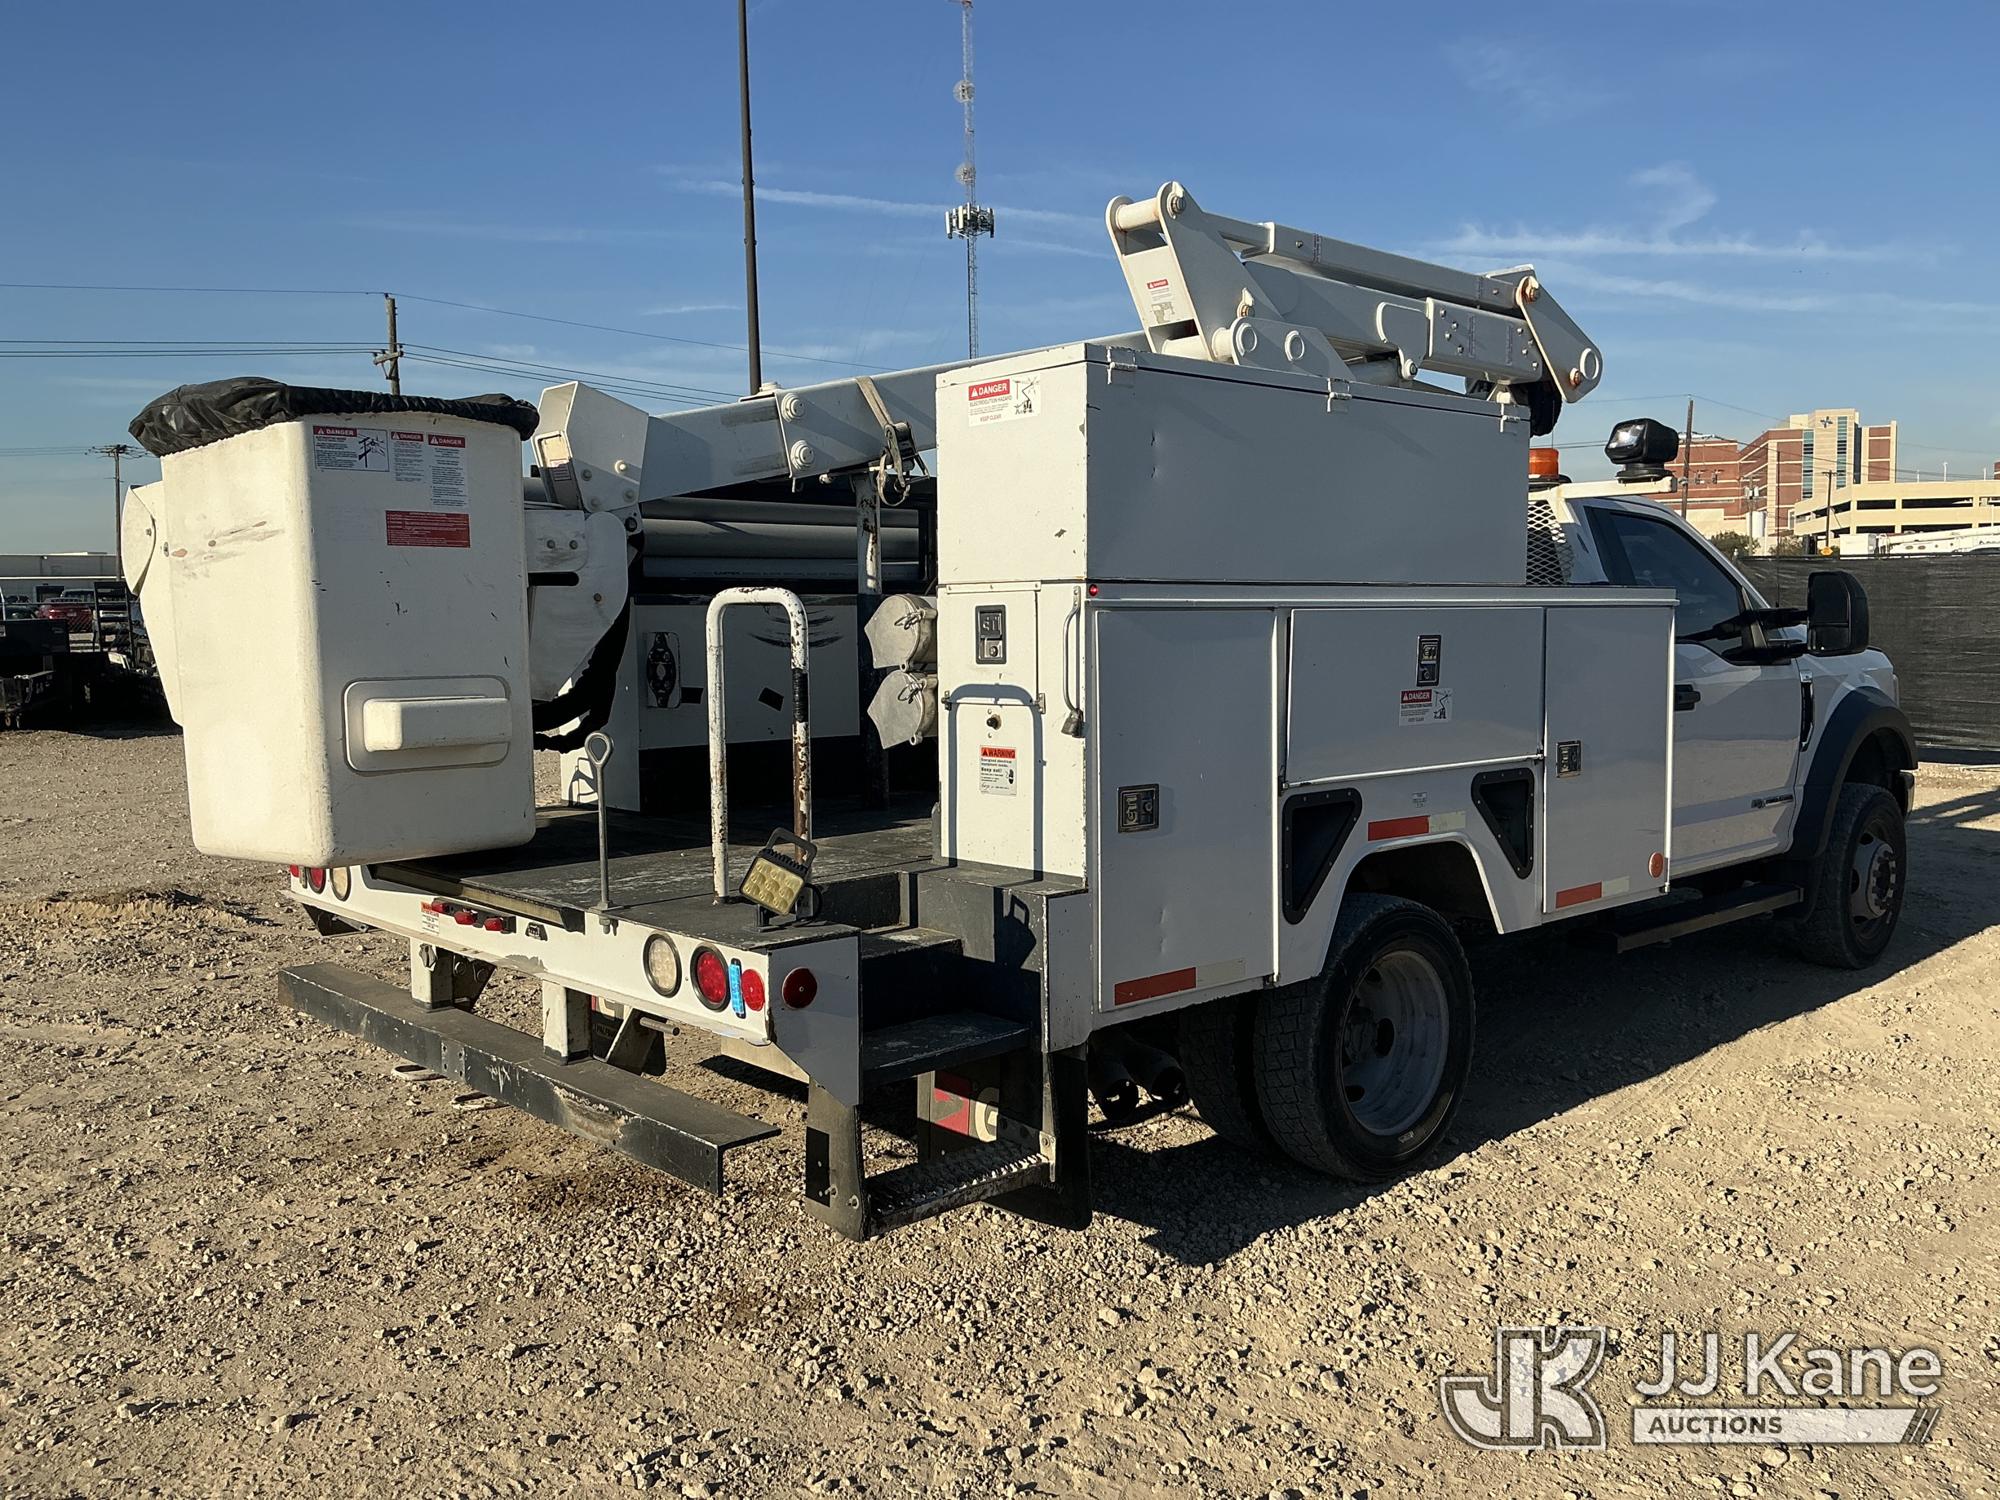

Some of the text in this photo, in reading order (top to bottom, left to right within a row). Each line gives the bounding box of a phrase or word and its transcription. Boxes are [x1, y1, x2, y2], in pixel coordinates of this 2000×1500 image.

[978, 383, 1008, 396] DANGER
[326, 428, 354, 436] DANGER
[439, 437, 462, 445] DANGER
[1408, 691, 1430, 700] DANGER
